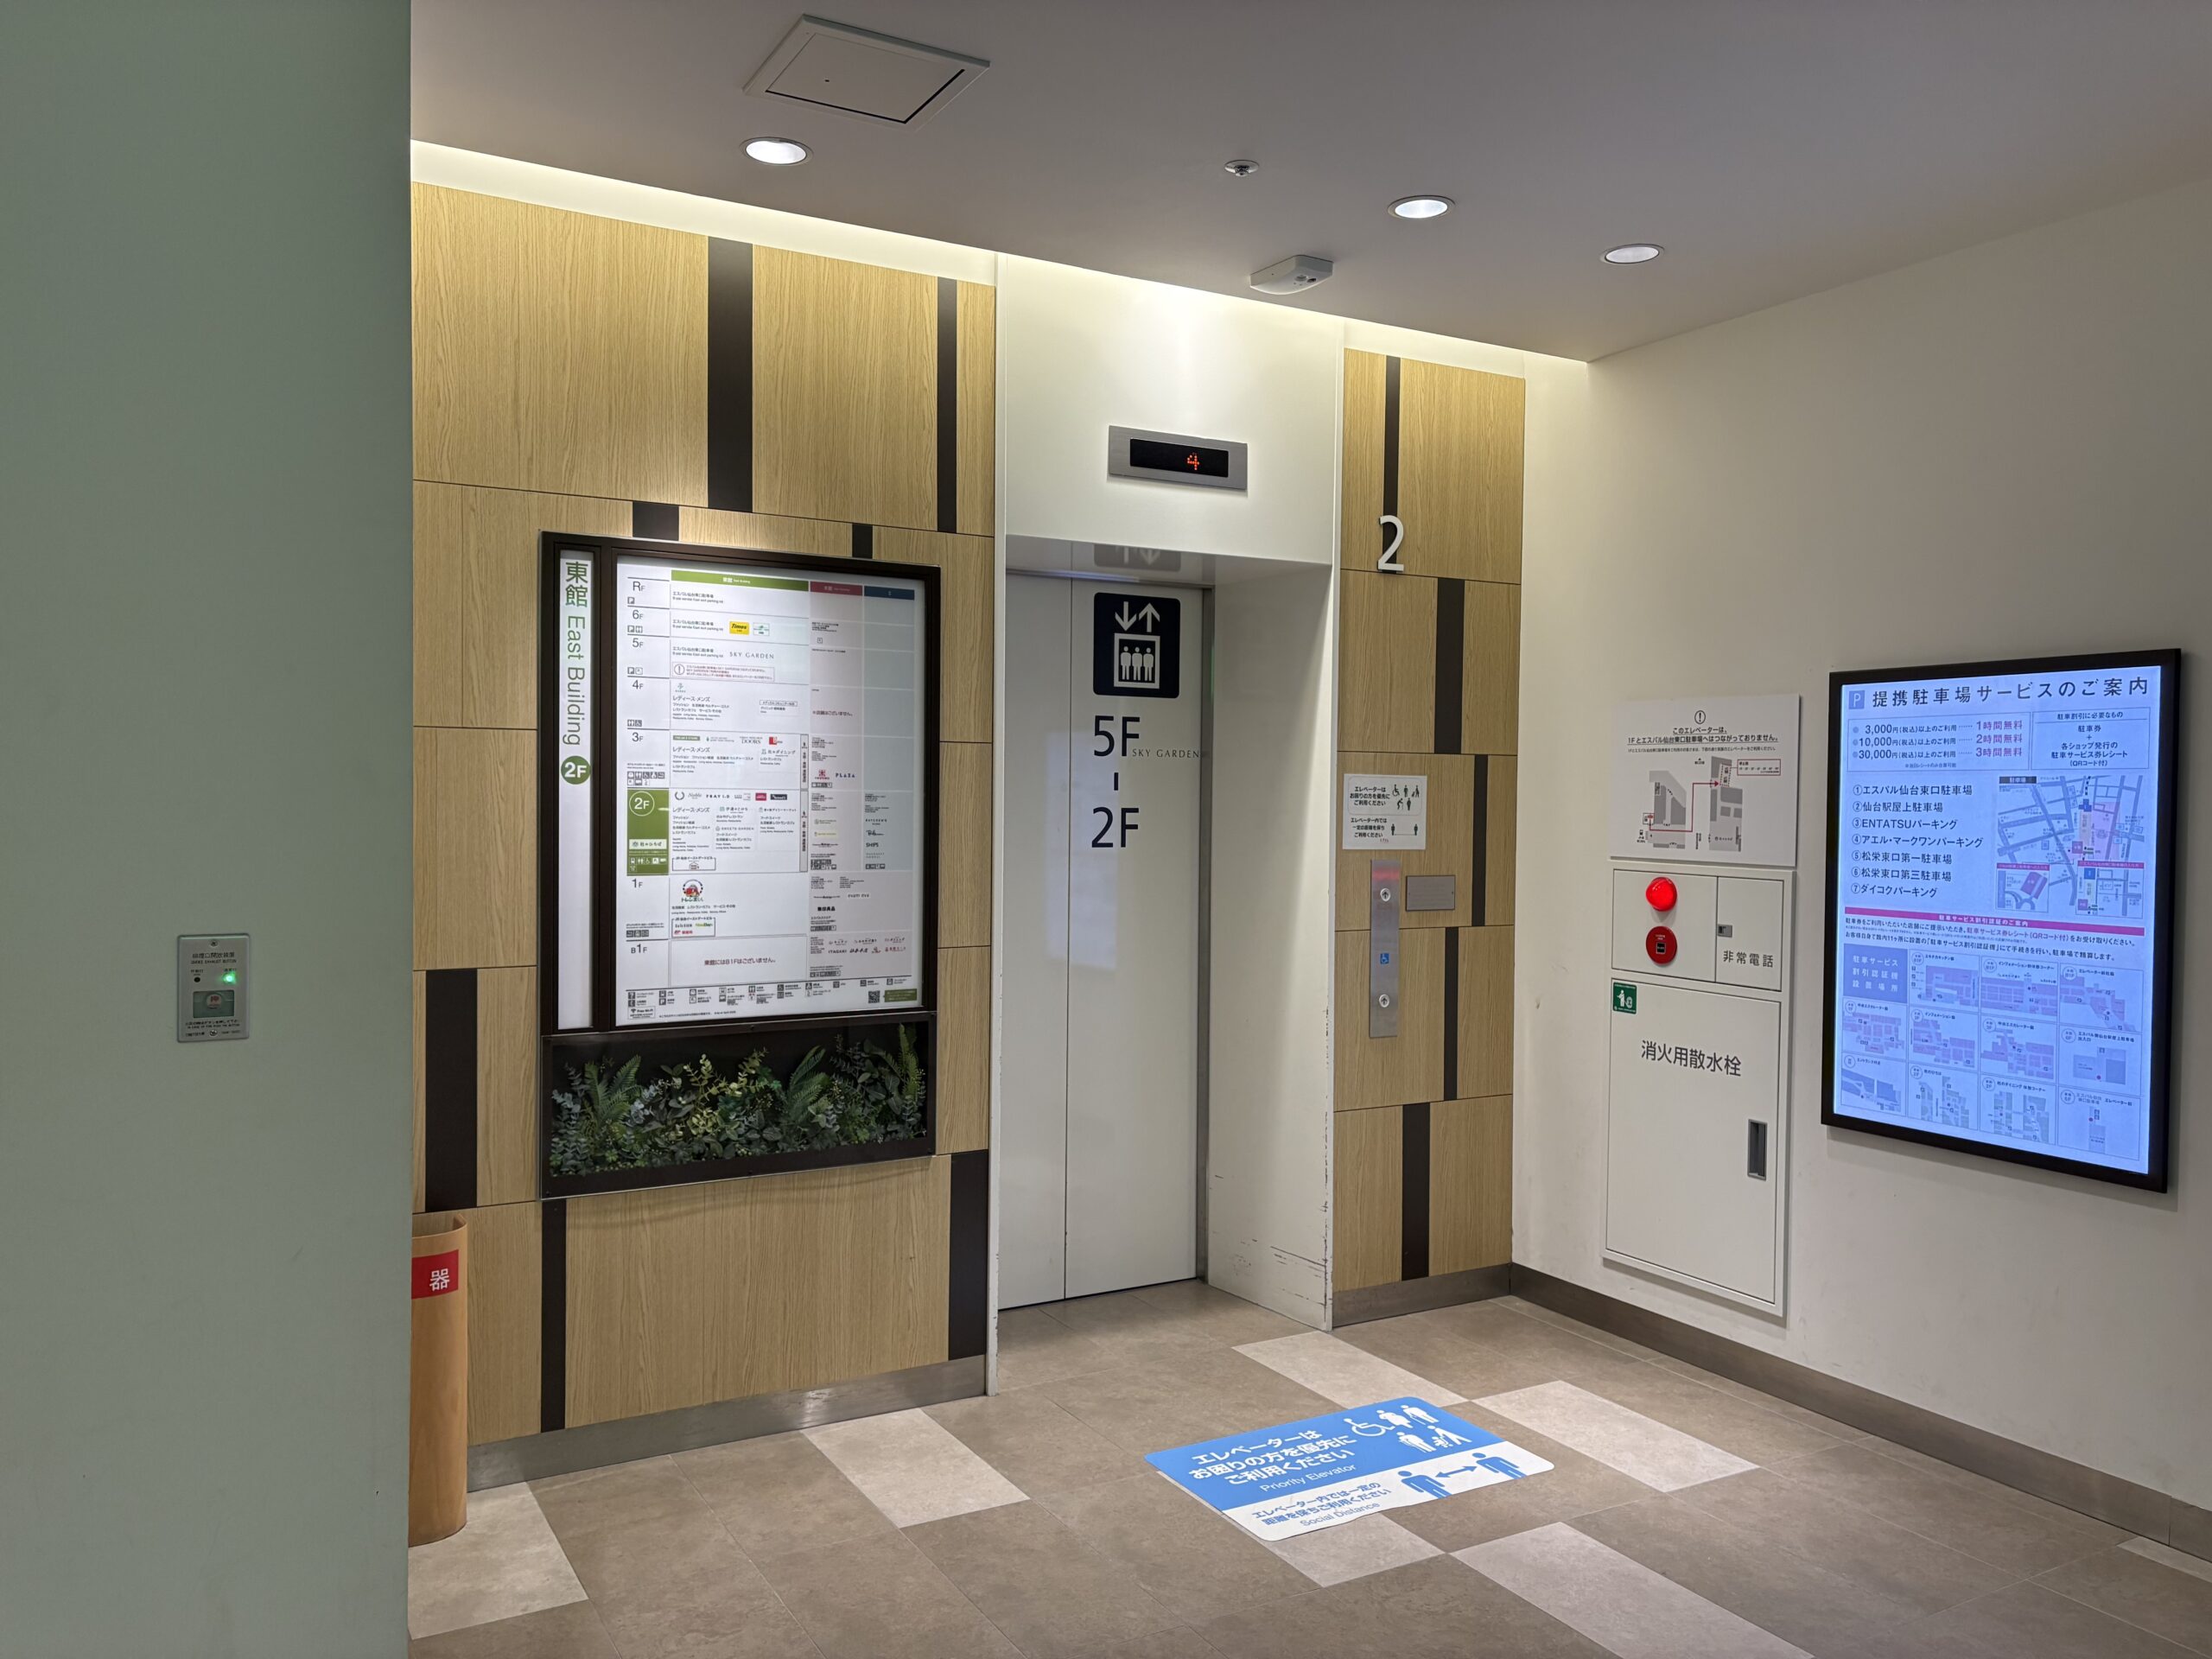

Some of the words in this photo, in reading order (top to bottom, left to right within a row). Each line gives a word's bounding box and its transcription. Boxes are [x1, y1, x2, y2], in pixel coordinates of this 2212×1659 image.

[1186, 452, 1200, 471] 4
[1377, 515, 1405, 572] 2
[565, 561, 588, 608] 東館
[632, 581, 645, 592] RF
[632, 609, 644, 620] 6F
[567, 614, 586, 660] East
[632, 638, 644, 648] 5F
[632, 679, 644, 690] 4F
[1872, 677, 2148, 708] 提携駐車場サービスのご案内
[563, 666, 585, 746] Building
[2056, 711, 2124, 721] 駐車割引に必要なもの
[1976, 720, 2023, 732] 1時間無料
[2077, 724, 2101, 734] 駐車券
[632, 732, 644, 742] 3F
[1093, 715, 1141, 757] 5F
[1975, 734, 2023, 745] 2時間無料
[1132, 748, 1150, 758] SKY
[1156, 748, 1199, 759] GARDEN
[1975, 747, 2023, 758] 3時間無料
[2051, 750, 2128, 760] 駐車サービス券レシート
[2061, 741, 2118, 751] 各ショップ発行の
[564, 761, 588, 779] 2F
[634, 799, 650, 810] 2F
[1091, 806, 1140, 849] 2F
[632, 878, 643, 888] 1F
[1723, 950, 1774, 968] 非常電話
[1853, 955, 1898, 967] 駐車サービス
[1641, 1039, 1742, 1077] 消火用散水栓
[429, 1268, 450, 1291] 器
[1189, 1434, 1357, 1479] お困りの方を優先に
[1192, 1430, 1323, 1465] エレベーターは
[1224, 1449, 1356, 1484] ご利用ください
[1259, 1477, 1306, 1492] Priority
[1309, 1463, 1357, 1481] Elevator
[1251, 1482, 1382, 1519] エレベーター内では一定の
[1261, 1489, 1392, 1526] 距離を保ちご利用ください
[1300, 1514, 1334, 1527] Social
[1337, 1502, 1381, 1518] Distance
